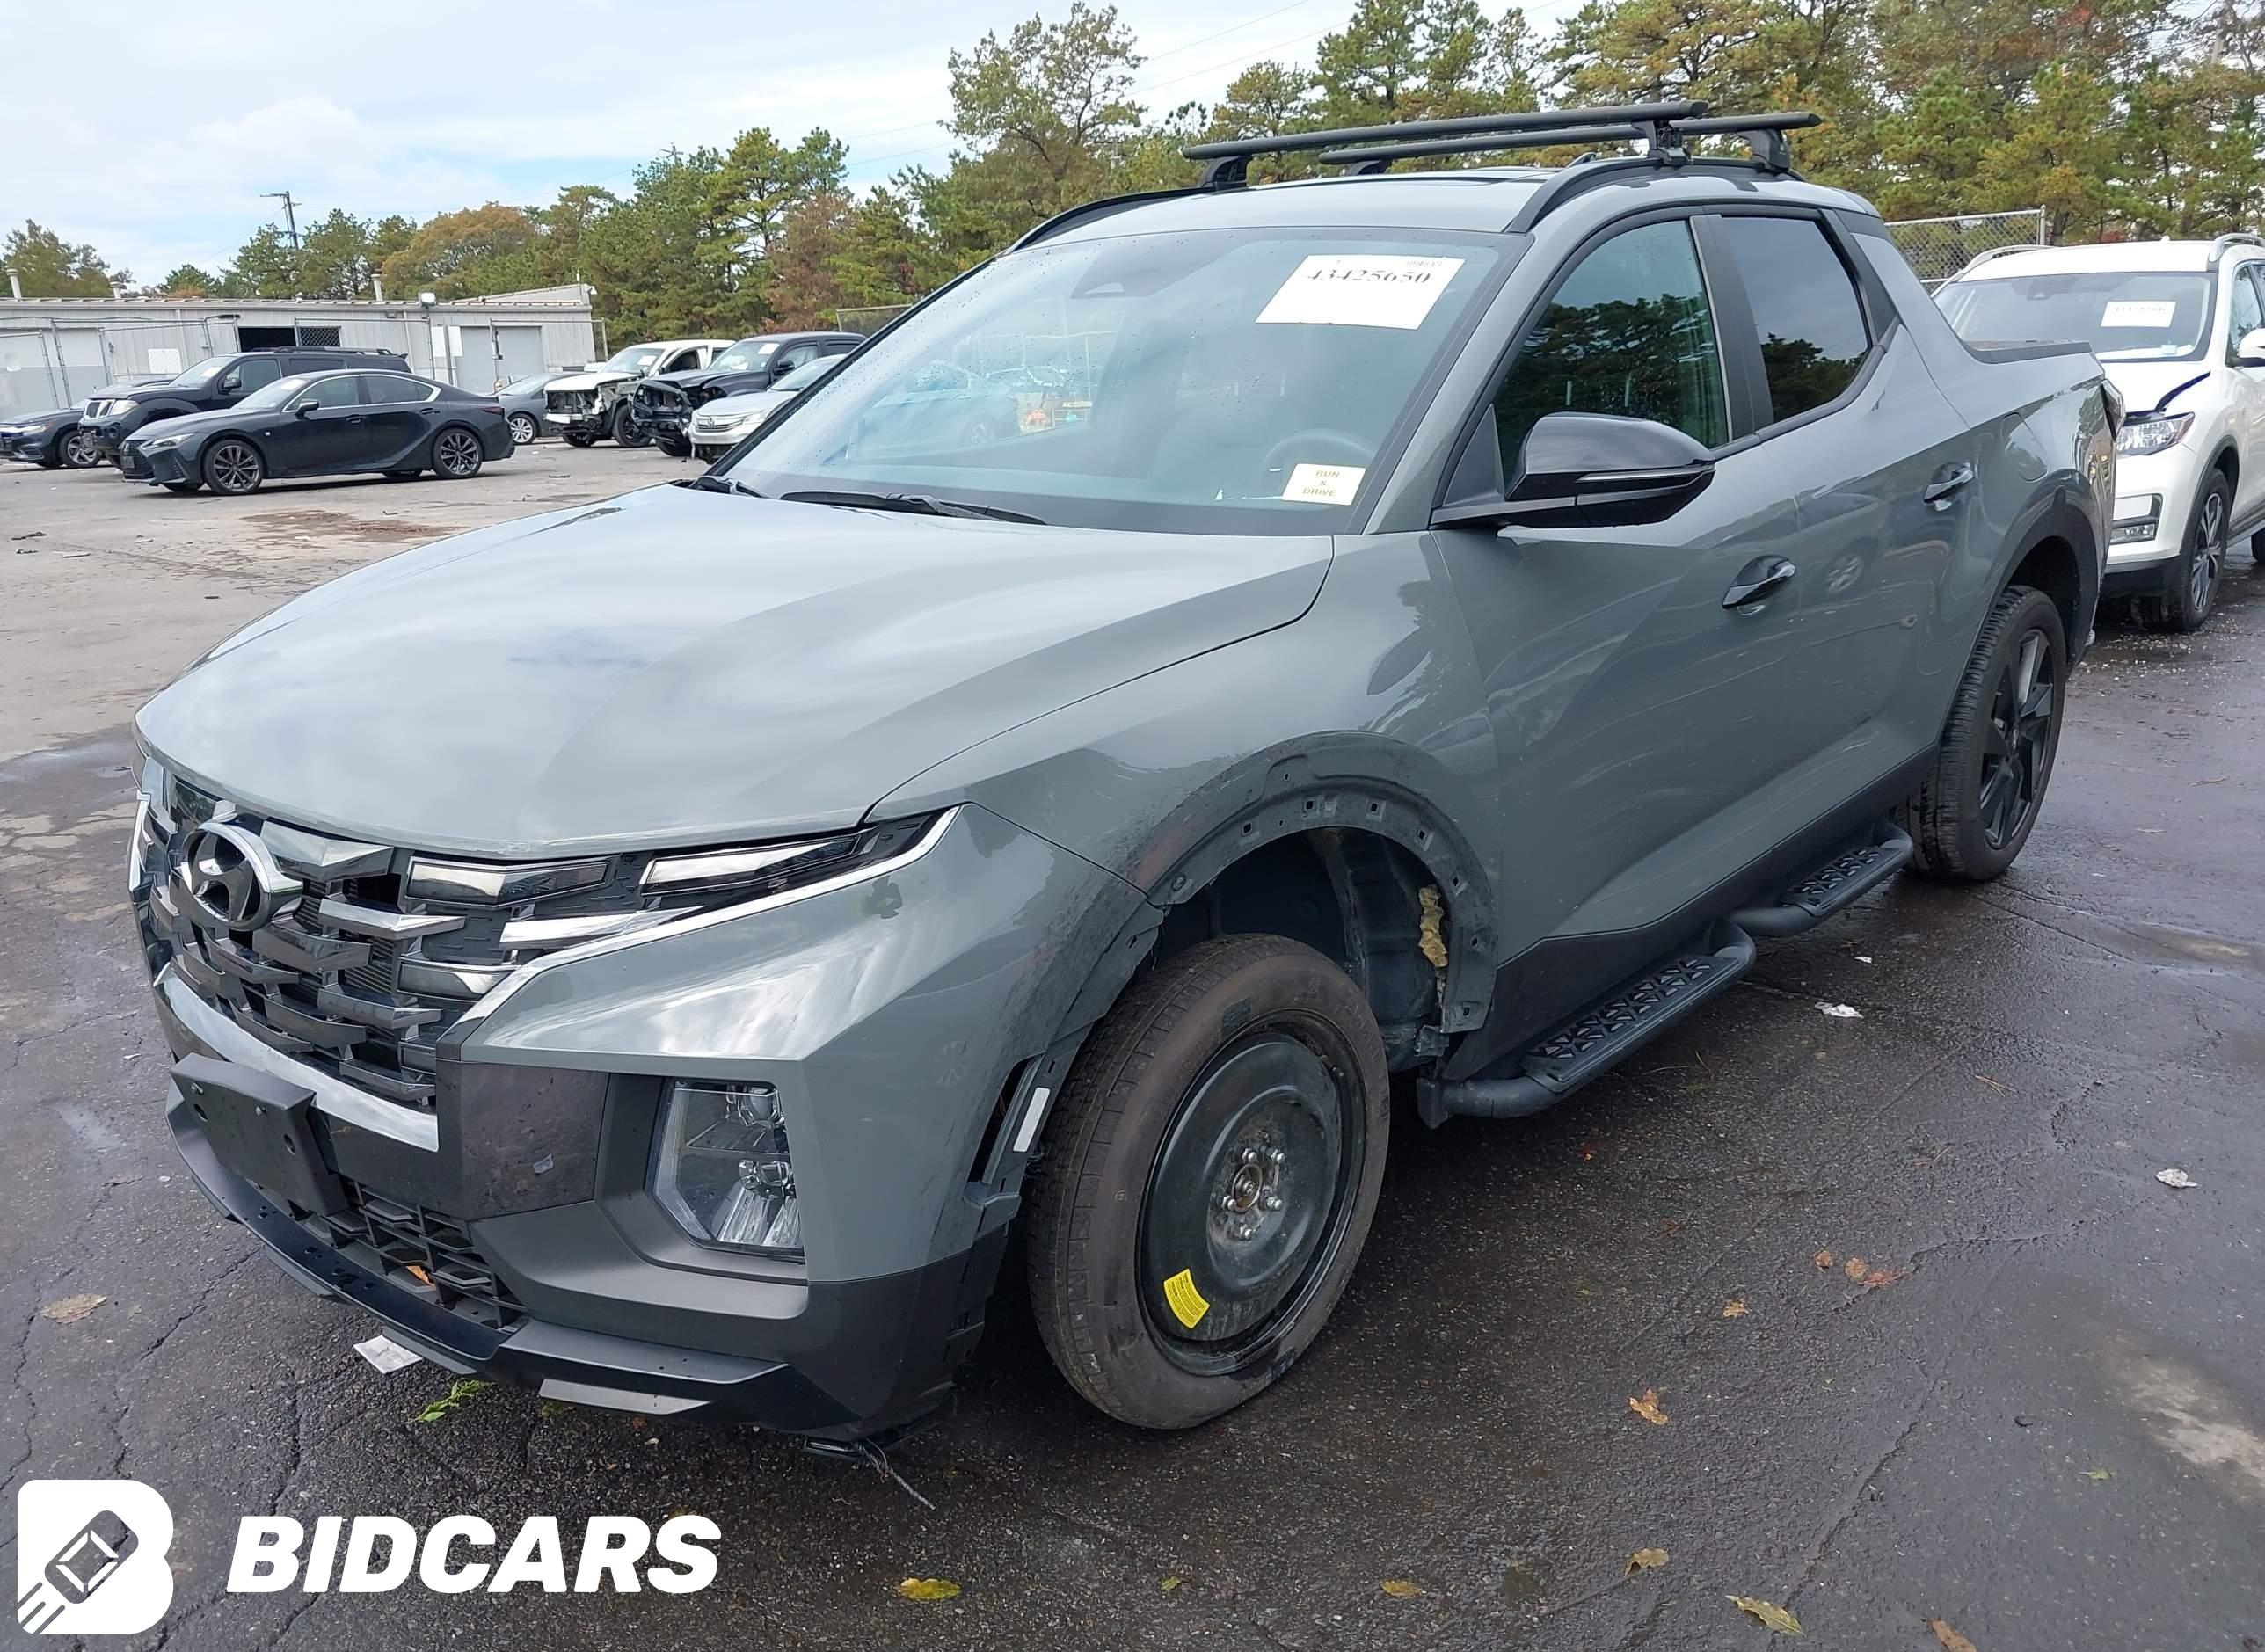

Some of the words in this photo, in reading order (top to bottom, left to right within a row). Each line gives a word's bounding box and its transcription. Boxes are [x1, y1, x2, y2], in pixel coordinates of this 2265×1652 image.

[1307, 269, 1431, 283] 43425650
[1315, 469, 1341, 478] RUN
[1302, 487, 1336, 497] DRIVE
